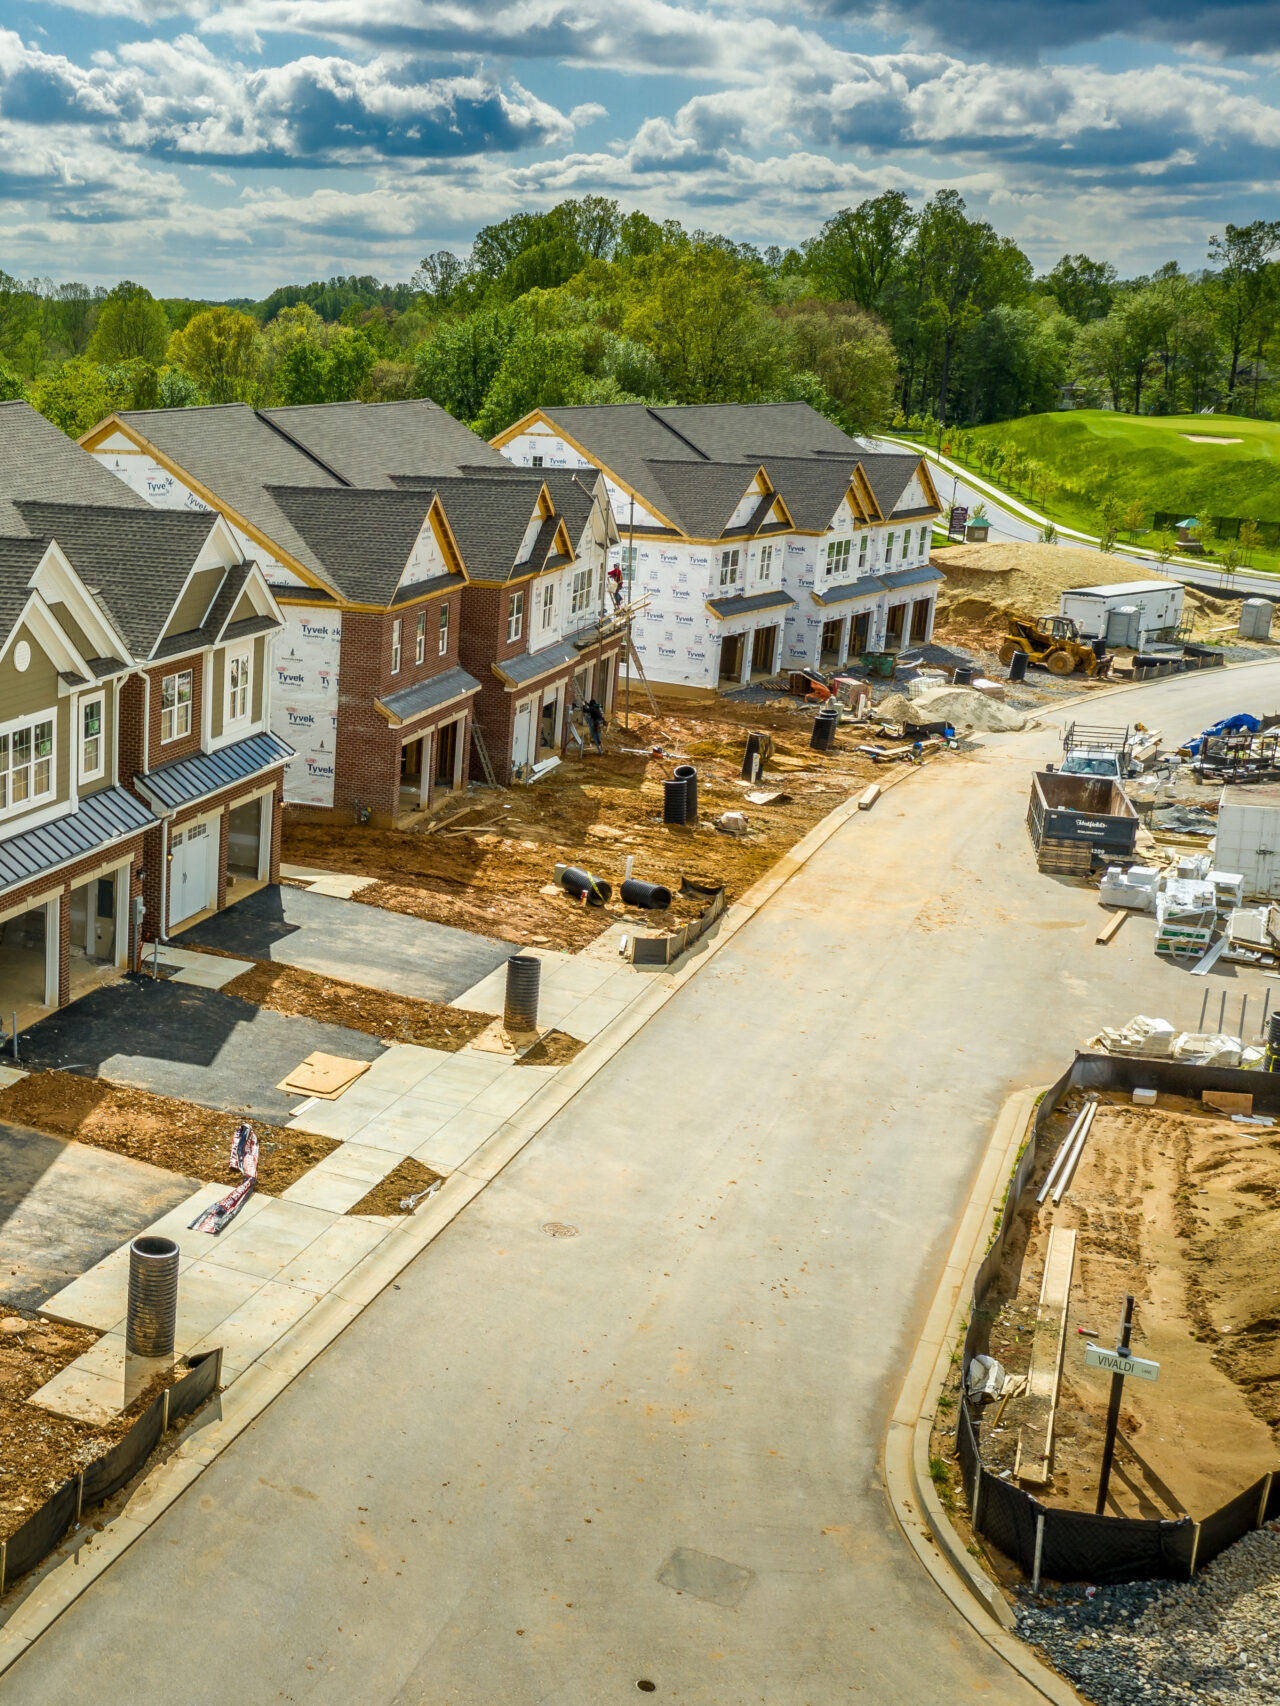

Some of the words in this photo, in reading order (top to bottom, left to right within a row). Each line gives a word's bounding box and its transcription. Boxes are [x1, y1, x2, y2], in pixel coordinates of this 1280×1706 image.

[302, 625, 328, 634] Tyvek
[278, 672, 304, 682] Tyvek
[288, 713, 315, 723] Tyvek
[307, 764, 334, 774] Tyvek
[1098, 1355, 1134, 1372] VIVALDI
